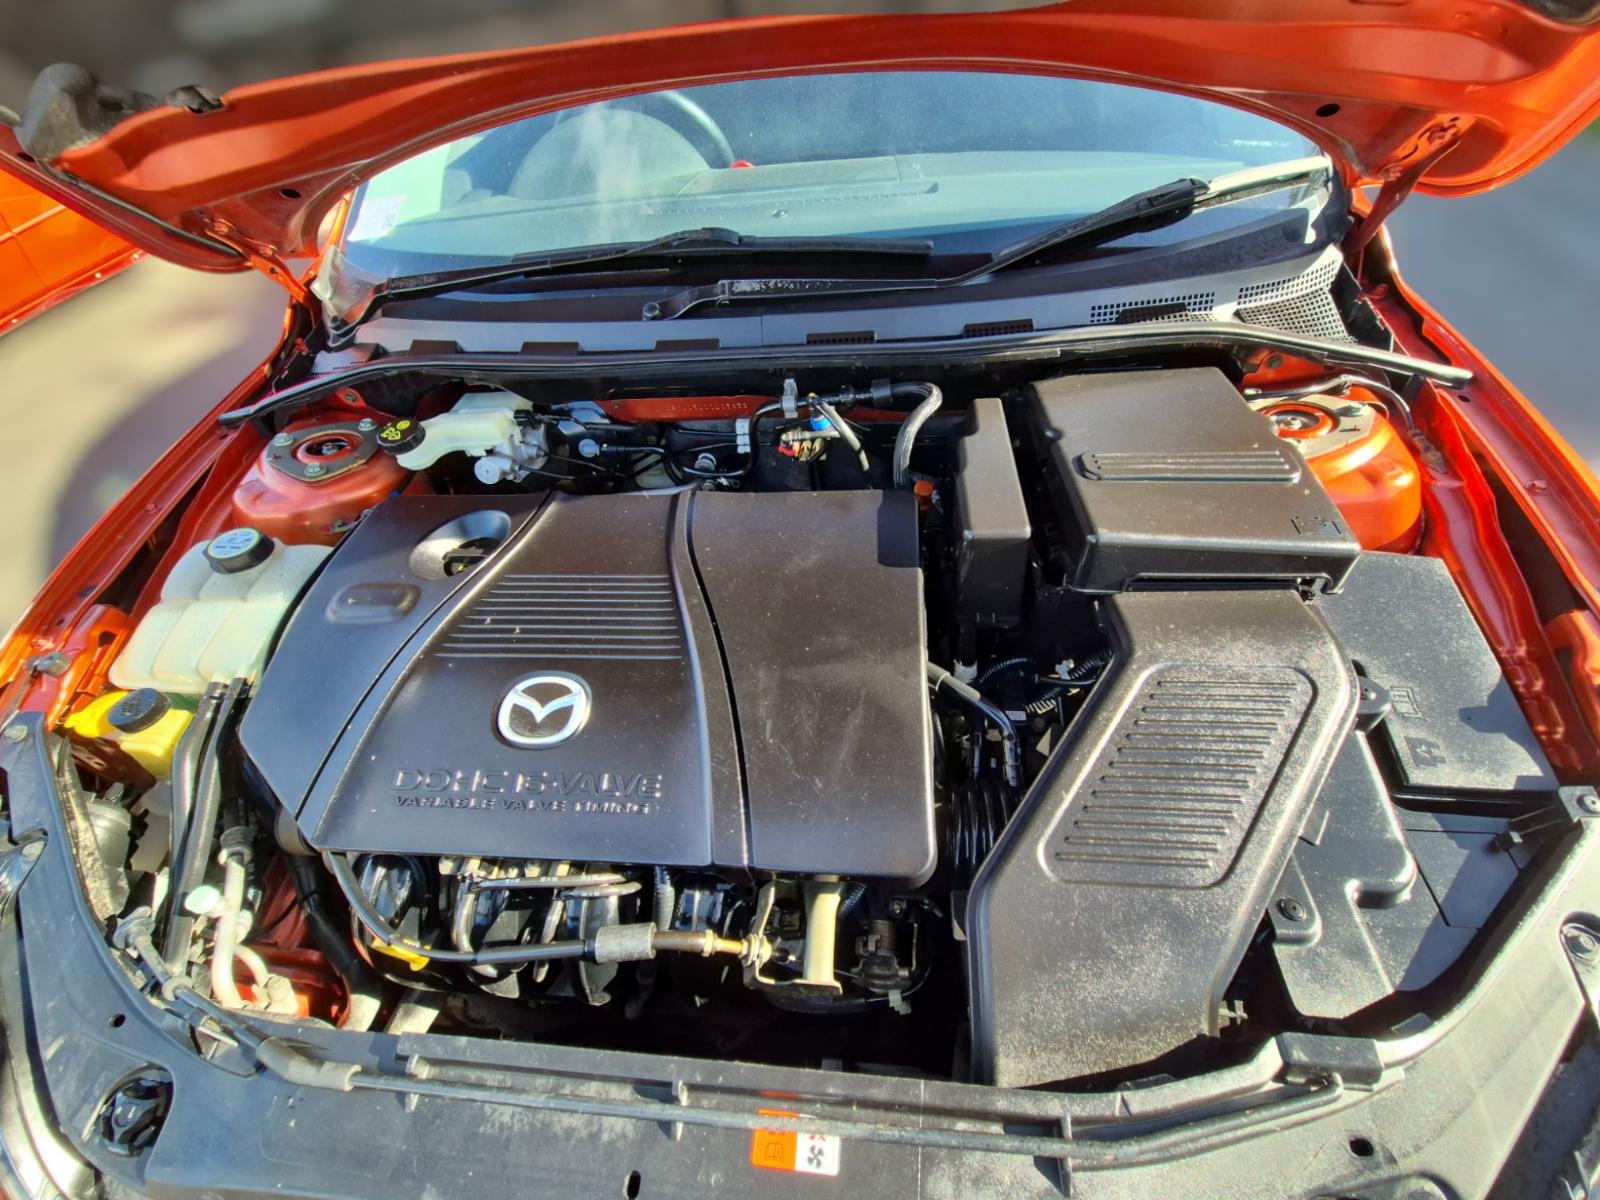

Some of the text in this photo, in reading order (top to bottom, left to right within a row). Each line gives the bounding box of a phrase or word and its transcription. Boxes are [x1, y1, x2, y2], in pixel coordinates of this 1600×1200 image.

[391, 769, 509, 793] DOHC
[393, 796, 649, 816] VARIABLE VALVE TIMING
